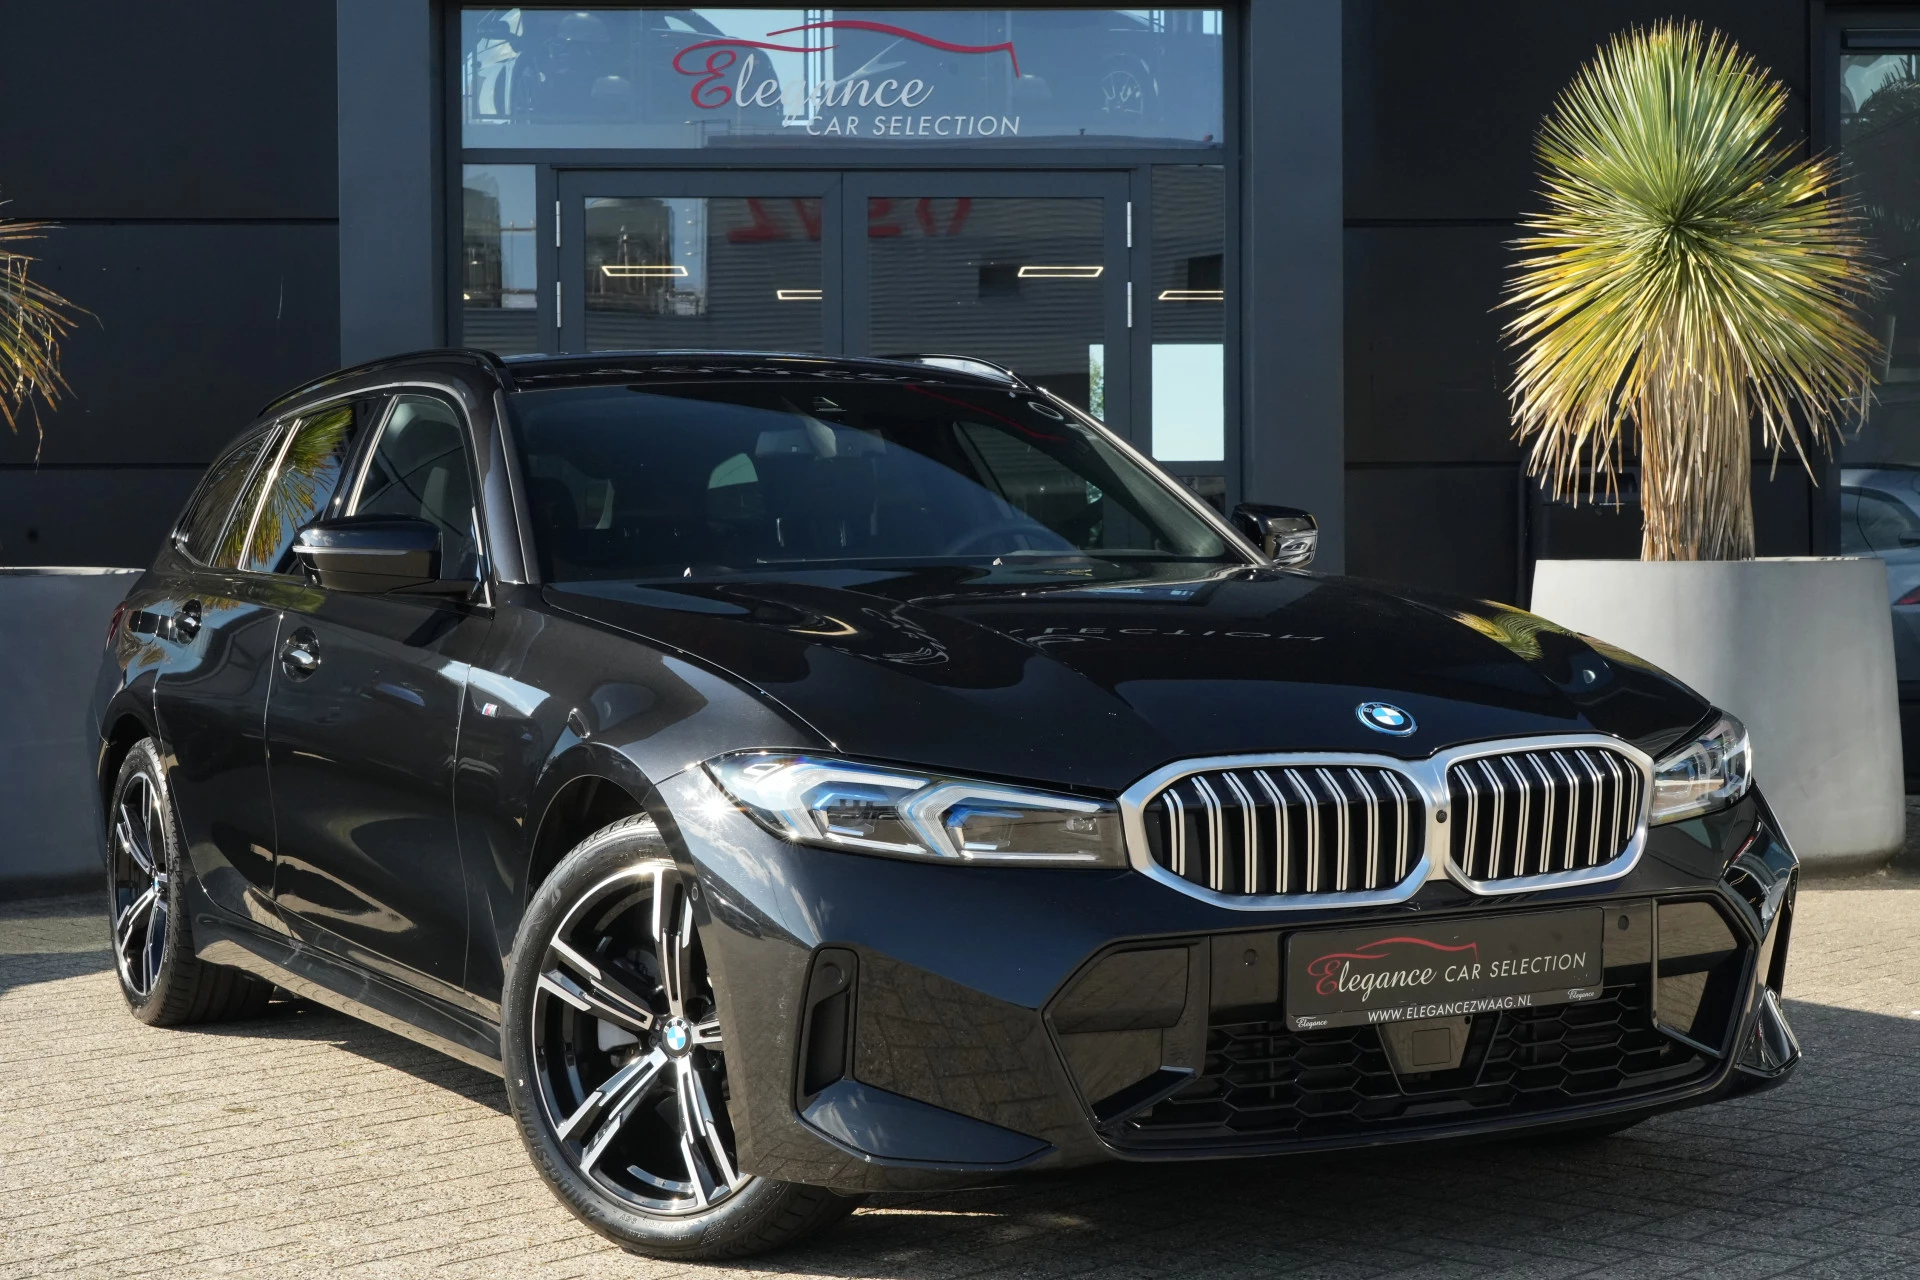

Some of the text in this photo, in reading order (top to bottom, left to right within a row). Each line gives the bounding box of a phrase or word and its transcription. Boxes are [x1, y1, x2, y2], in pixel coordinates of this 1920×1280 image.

[673, 40, 934, 128] Elegance
[806, 116, 1020, 135] CAR SELECTION
[1307, 952, 1586, 1002] Elegance CAR SELECTION
[1568, 989, 1596, 1000] Elegance
[1367, 995, 1532, 1022] WWW.ELEGANCEZWAAG.NL
[1295, 1016, 1328, 1029] Elegance
